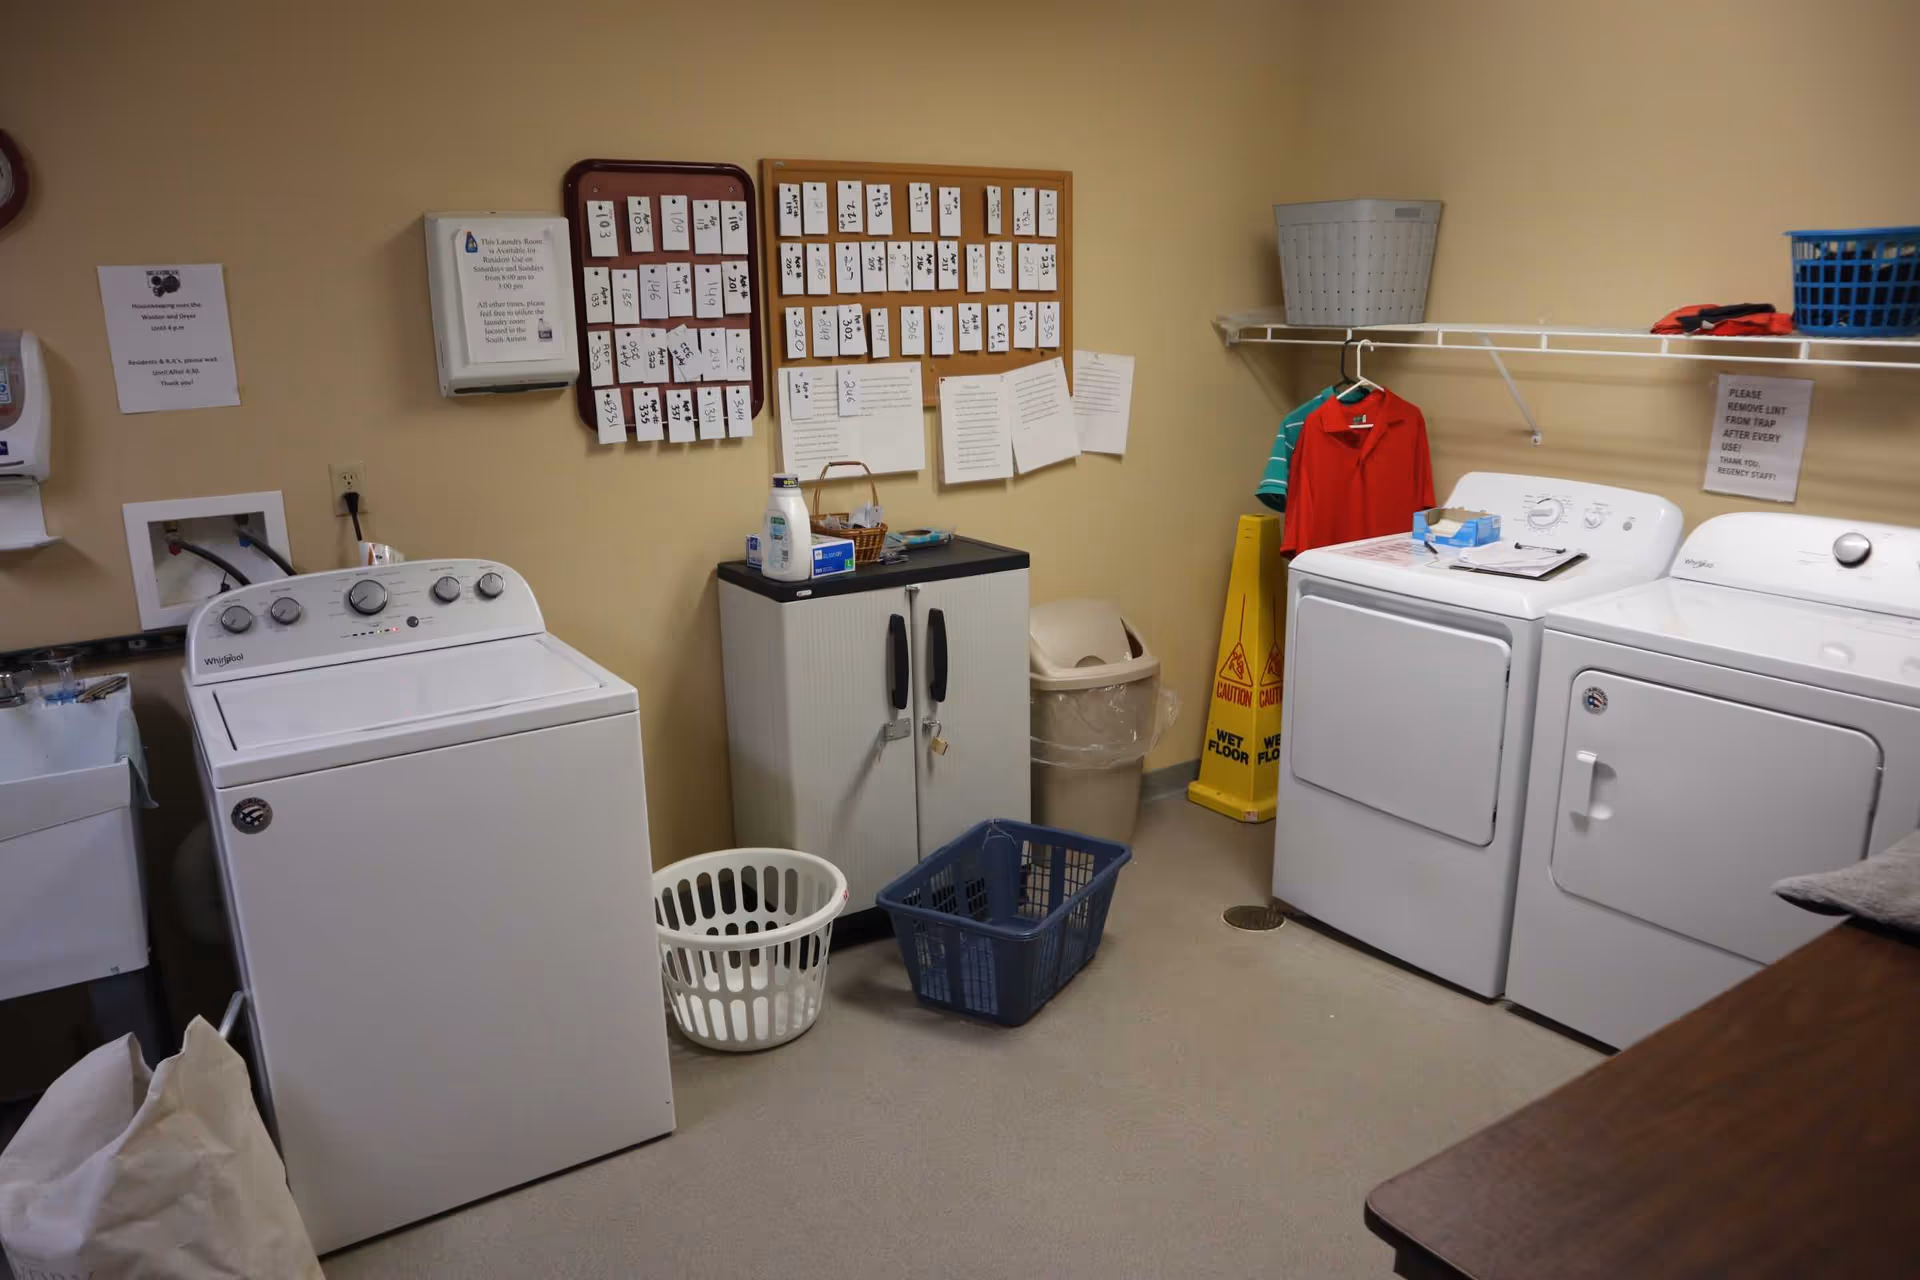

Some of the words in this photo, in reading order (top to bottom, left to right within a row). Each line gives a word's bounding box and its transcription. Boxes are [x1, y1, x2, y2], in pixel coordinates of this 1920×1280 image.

[847, 200, 856, 223] 122
[872, 197, 883, 217] 123
[915, 197, 923, 213] 127
[596, 213, 611, 239] 103
[633, 212, 644, 234] 108
[671, 212, 684, 234] 109
[696, 218, 704, 230] 113
[728, 216, 739, 231] 118
[497, 238, 522, 246] Laundry
[518, 265, 544, 273] Sundays
[1040, 256, 1049, 276] 223
[646, 279, 661, 301] 146
[672, 279, 681, 295] 147
[728, 277, 737, 293] 201
[591, 292, 599, 308] 133
[702, 281, 719, 306] 149
[484, 319, 507, 327] laundry
[843, 319, 853, 342] 302
[793, 318, 804, 351] 320
[592, 345, 602, 371] 303
[1729, 388, 1762, 399] PLEASE
[638, 403, 650, 425] 335
[670, 404, 680, 422] 337
[704, 401, 716, 424] 134
[732, 400, 746, 421] 344
[1728, 402, 1764, 414] REMOVE
[1766, 406, 1788, 415] LINT
[1726, 416, 1751, 425] FROM
[1754, 418, 1776, 428] TRAP
[1723, 429, 1750, 440] AFTER
[1752, 432, 1781, 443] EVERY
[1722, 442, 1741, 452] USE!
[1720, 456, 1742, 465] THANK
[1718, 467, 1749, 477] REGENCY
[204, 652, 244, 668] Whirlpool
[1217, 681, 1252, 708] CAUTION
[1217, 728, 1244, 748] WET
[1264, 734, 1281, 749] WE
[1208, 739, 1248, 765] FLOOR
[1258, 750, 1280, 765] FLO
